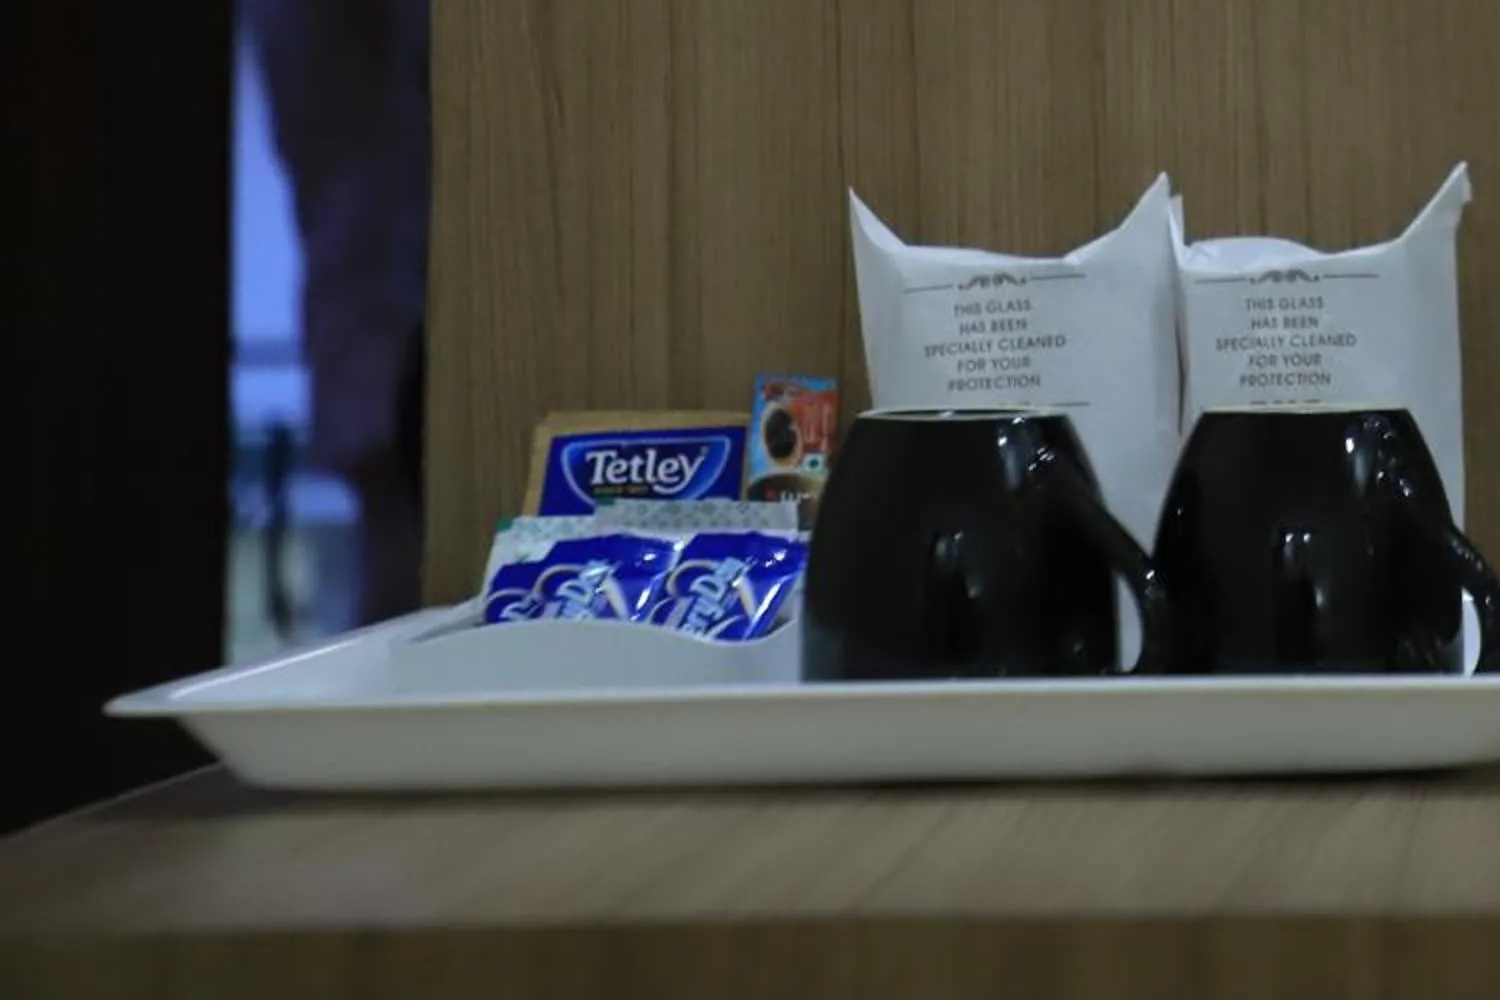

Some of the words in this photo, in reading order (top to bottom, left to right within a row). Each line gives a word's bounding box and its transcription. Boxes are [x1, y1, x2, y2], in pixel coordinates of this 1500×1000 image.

[954, 302, 982, 317] THIS
[985, 299, 1032, 314] GLASS
[1246, 297, 1274, 311] THIS
[1278, 296, 1324, 310] GLASS
[959, 320, 986, 336] HAS
[991, 317, 1028, 332] BEEN
[1251, 317, 1278, 330] HAS
[1283, 316, 1319, 329] BEEN
[924, 340, 993, 358] SPECIALLY
[997, 334, 1067, 351] CLEANED
[1215, 335, 1286, 351] SPECIALLY
[1289, 332, 1358, 347] CLEANED
[957, 358, 987, 373] FOR
[992, 355, 1031, 371] YOUR
[1248, 354, 1278, 368] FOR
[1283, 352, 1322, 367] YOUR
[947, 374, 1041, 392] PROTECTION
[1239, 372, 1332, 387] PROTECTION
[585, 445, 709, 495] Tetley
